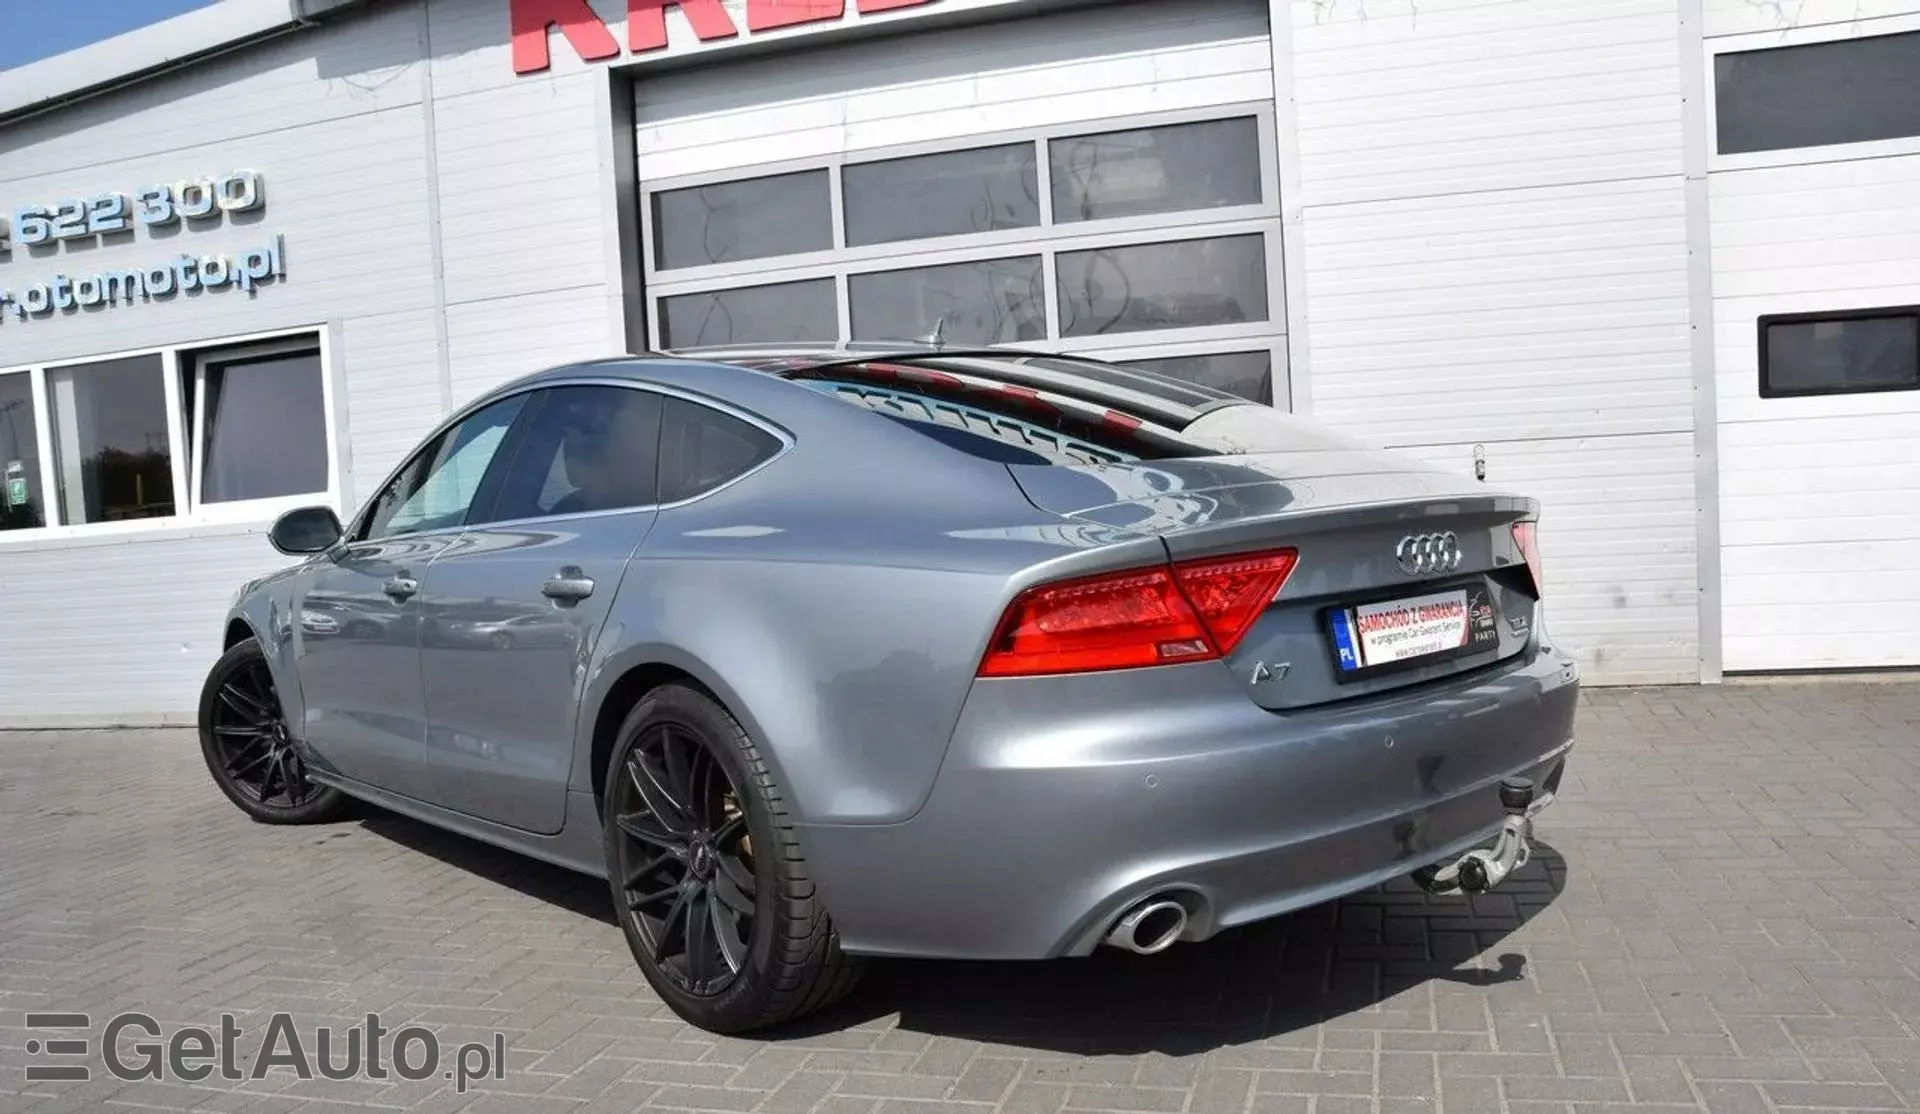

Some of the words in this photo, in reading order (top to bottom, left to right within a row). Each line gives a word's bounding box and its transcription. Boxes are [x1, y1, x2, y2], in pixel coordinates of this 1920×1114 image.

[13, 192, 130, 245] 622
[137, 168, 263, 225] 300
[0, 234, 285, 319] .otomoto.pl
[1411, 607, 1418, 624] Z
[1339, 648, 1353, 661] PL
[1251, 661, 1290, 685] A7
